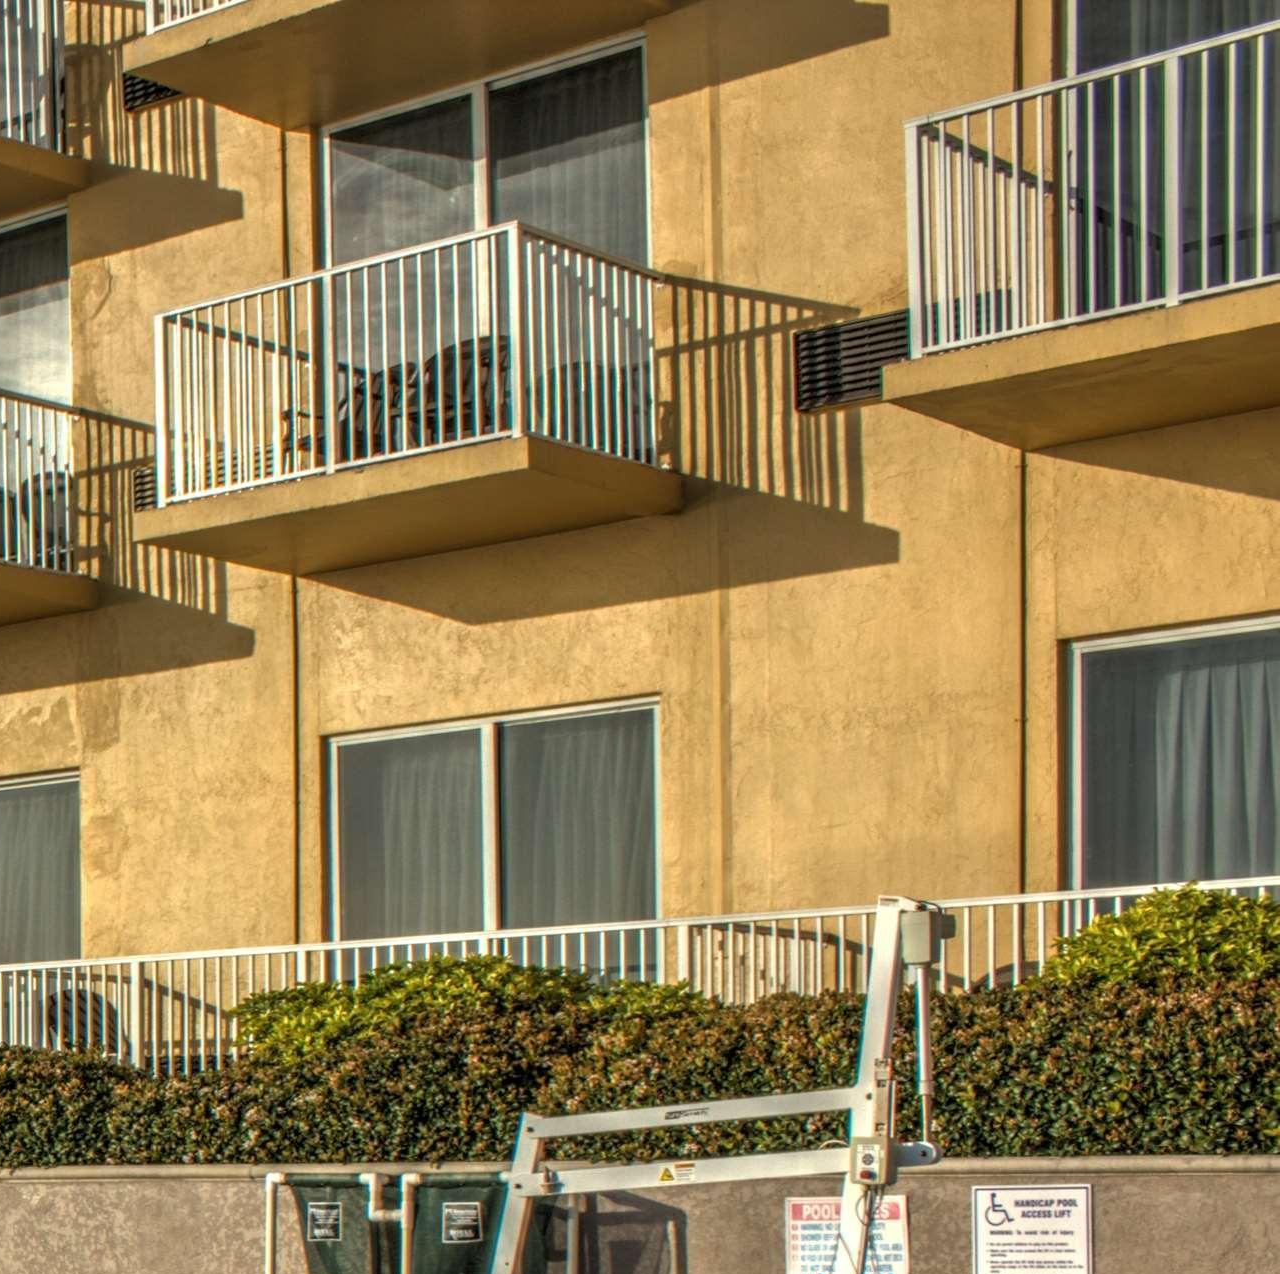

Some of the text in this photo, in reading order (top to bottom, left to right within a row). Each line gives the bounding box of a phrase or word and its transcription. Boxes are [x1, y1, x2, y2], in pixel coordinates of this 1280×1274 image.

[1014, 1199, 1078, 1207] HANDICAP POOL
[802, 1205, 840, 1219] POOL
[1021, 1210, 1071, 1218] ACCESS LIFT
